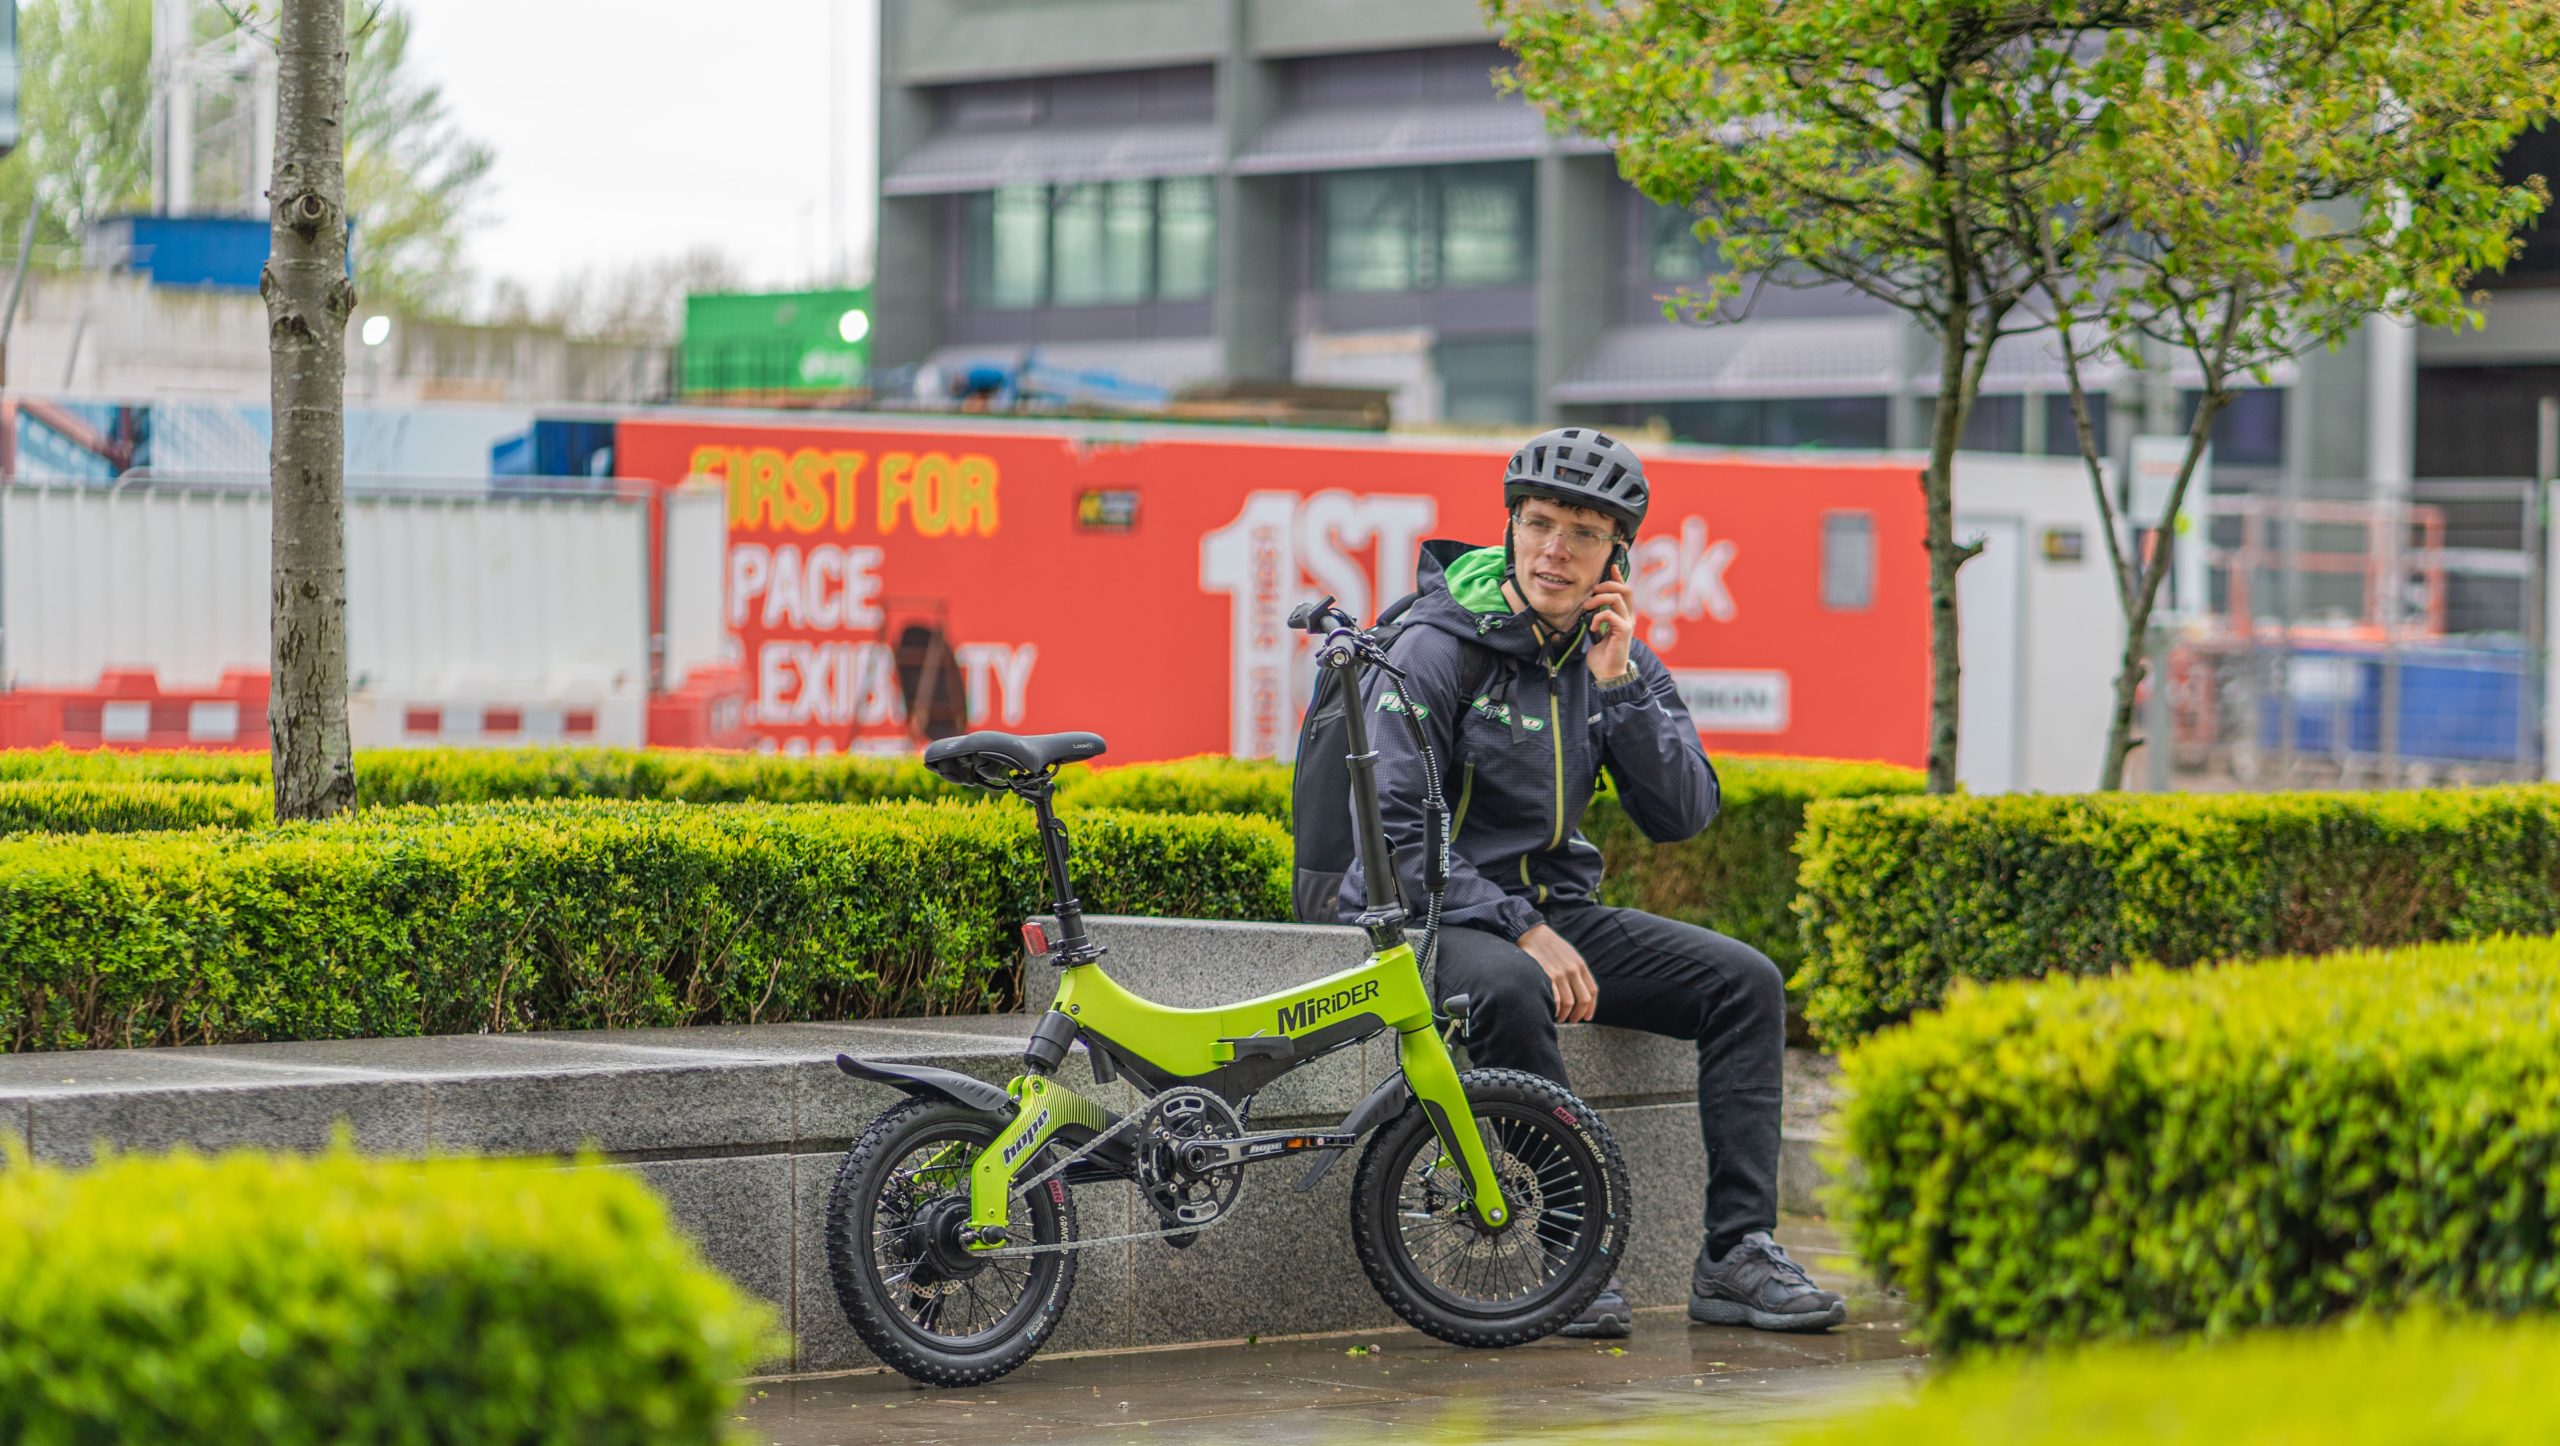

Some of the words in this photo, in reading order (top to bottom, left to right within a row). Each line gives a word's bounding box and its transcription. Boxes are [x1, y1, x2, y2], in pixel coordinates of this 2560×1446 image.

[877, 452, 998, 536] FOR
[1003, 1108, 1048, 1168] hope
[1248, 1142, 1282, 1154] hope
[1056, 1260, 1064, 1282] DELTA
[1047, 1282, 1059, 1306] GUARD
